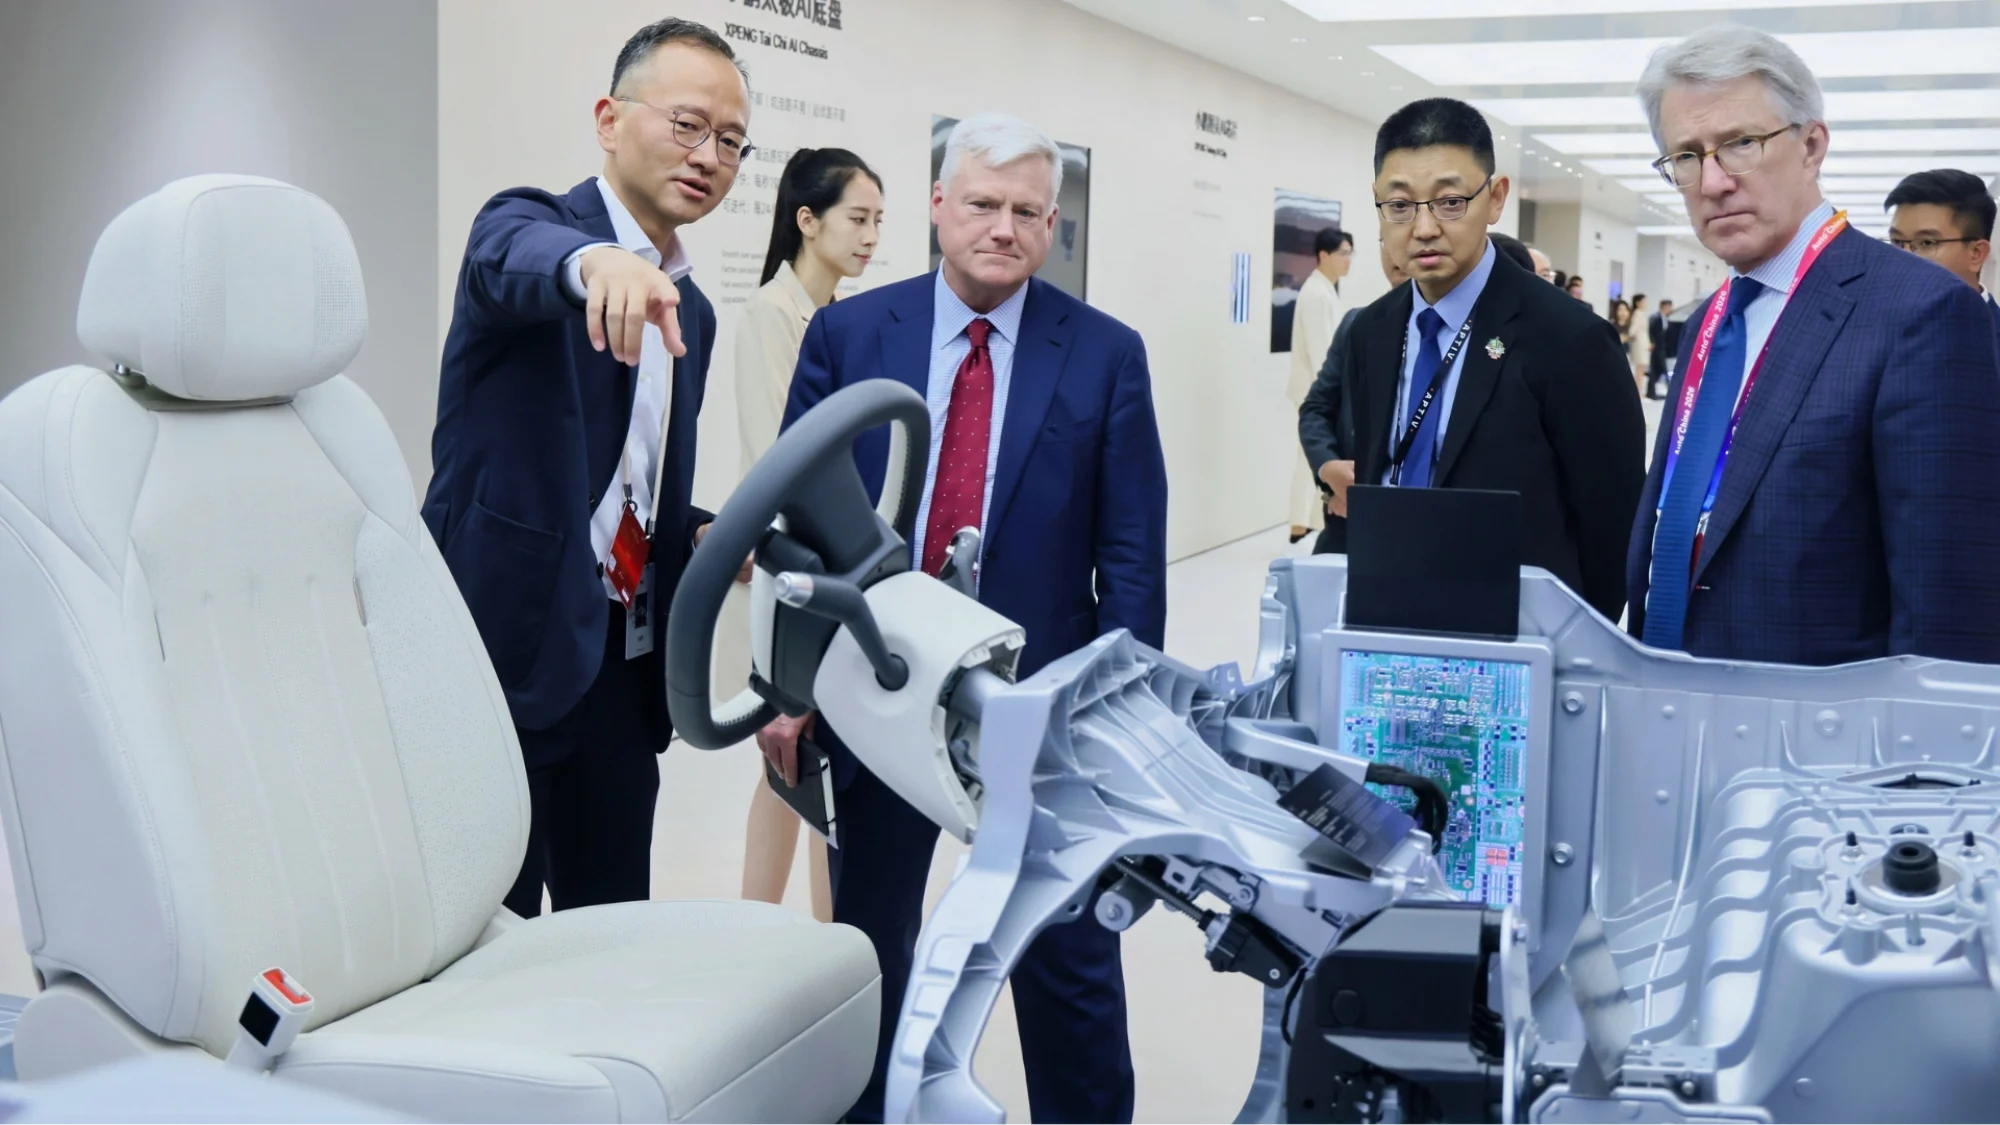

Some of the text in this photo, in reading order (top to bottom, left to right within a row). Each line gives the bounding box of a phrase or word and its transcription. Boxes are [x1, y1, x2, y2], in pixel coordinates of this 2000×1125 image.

[725, 22, 828, 59] XPENG Tai Chi AI Chassis
[1811, 232, 1828, 251] Auto
[1447, 323, 1471, 360] APTIV
[1697, 290, 1727, 360] Auto China 2026
[1411, 391, 1432, 429] APTIV
[1674, 386, 1695, 455] Auto China 2026
